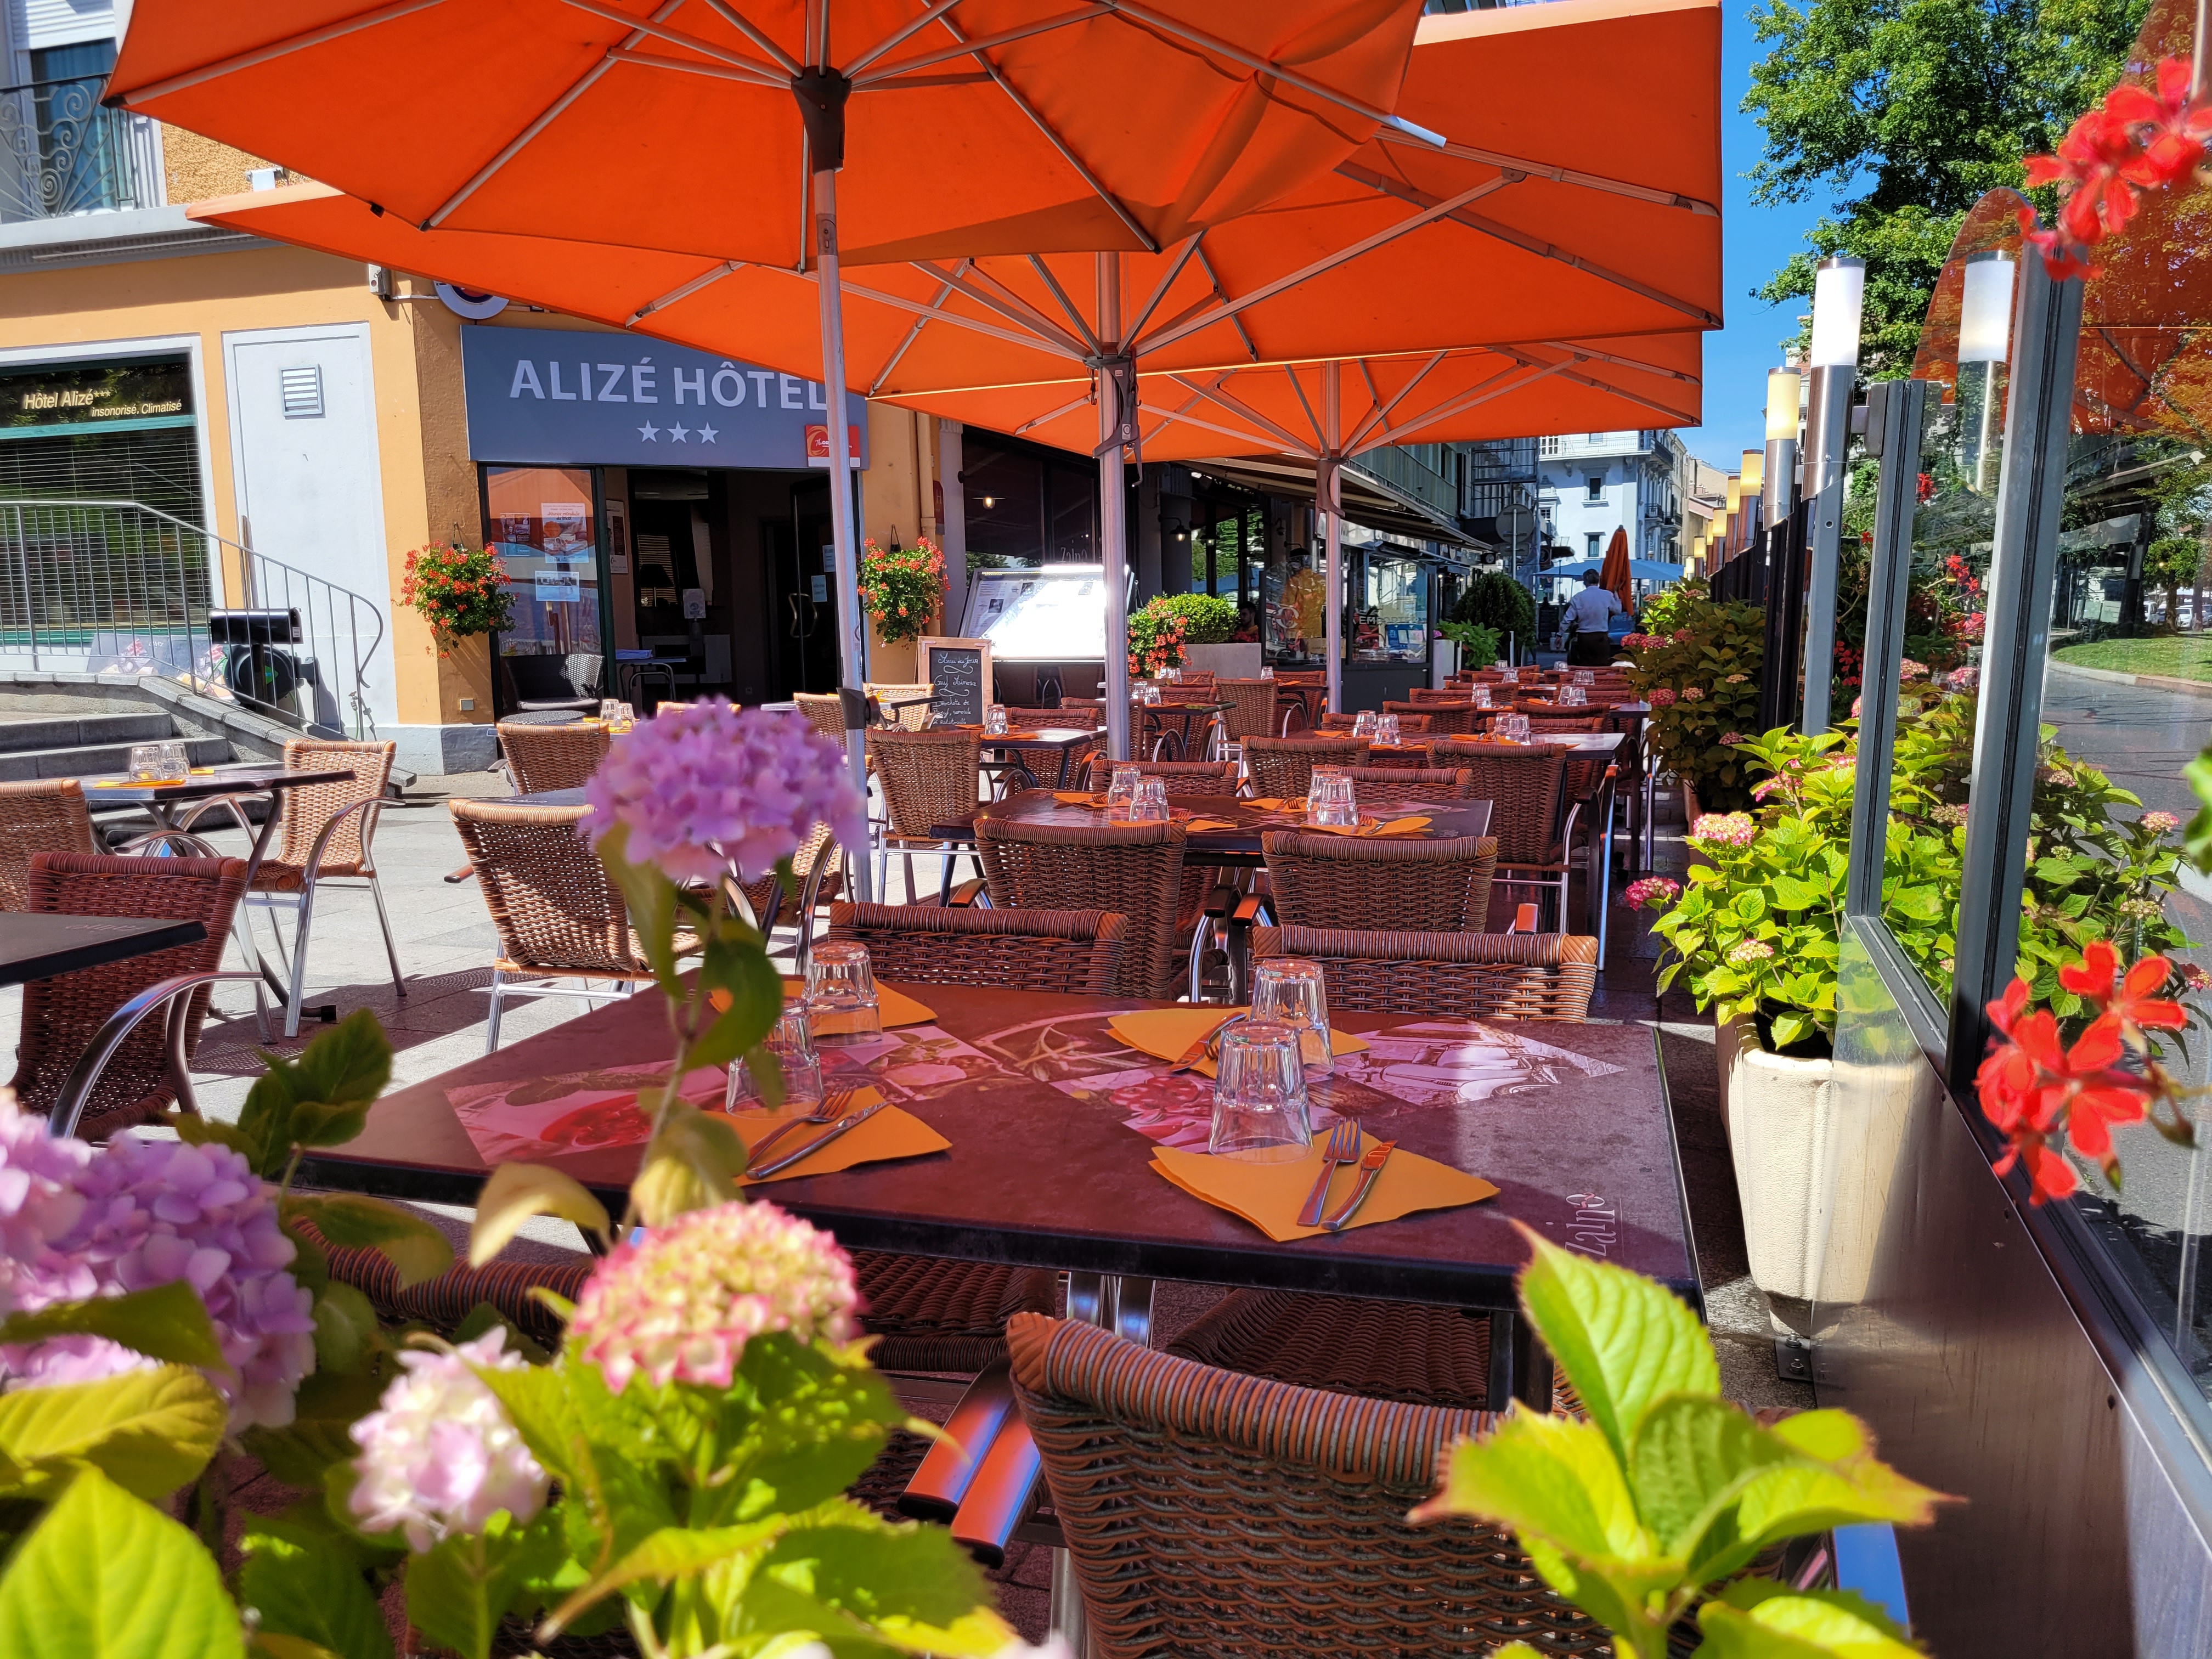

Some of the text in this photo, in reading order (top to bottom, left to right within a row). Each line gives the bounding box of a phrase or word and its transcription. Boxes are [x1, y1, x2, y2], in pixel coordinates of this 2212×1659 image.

[25, 388, 94, 409] Hôtel Alizé
[510, 357, 827, 410] ALIZÉ HÔTEL
[141, 399, 182, 414] Climatisé
[1545, 1192, 1616, 1257] Zaino
